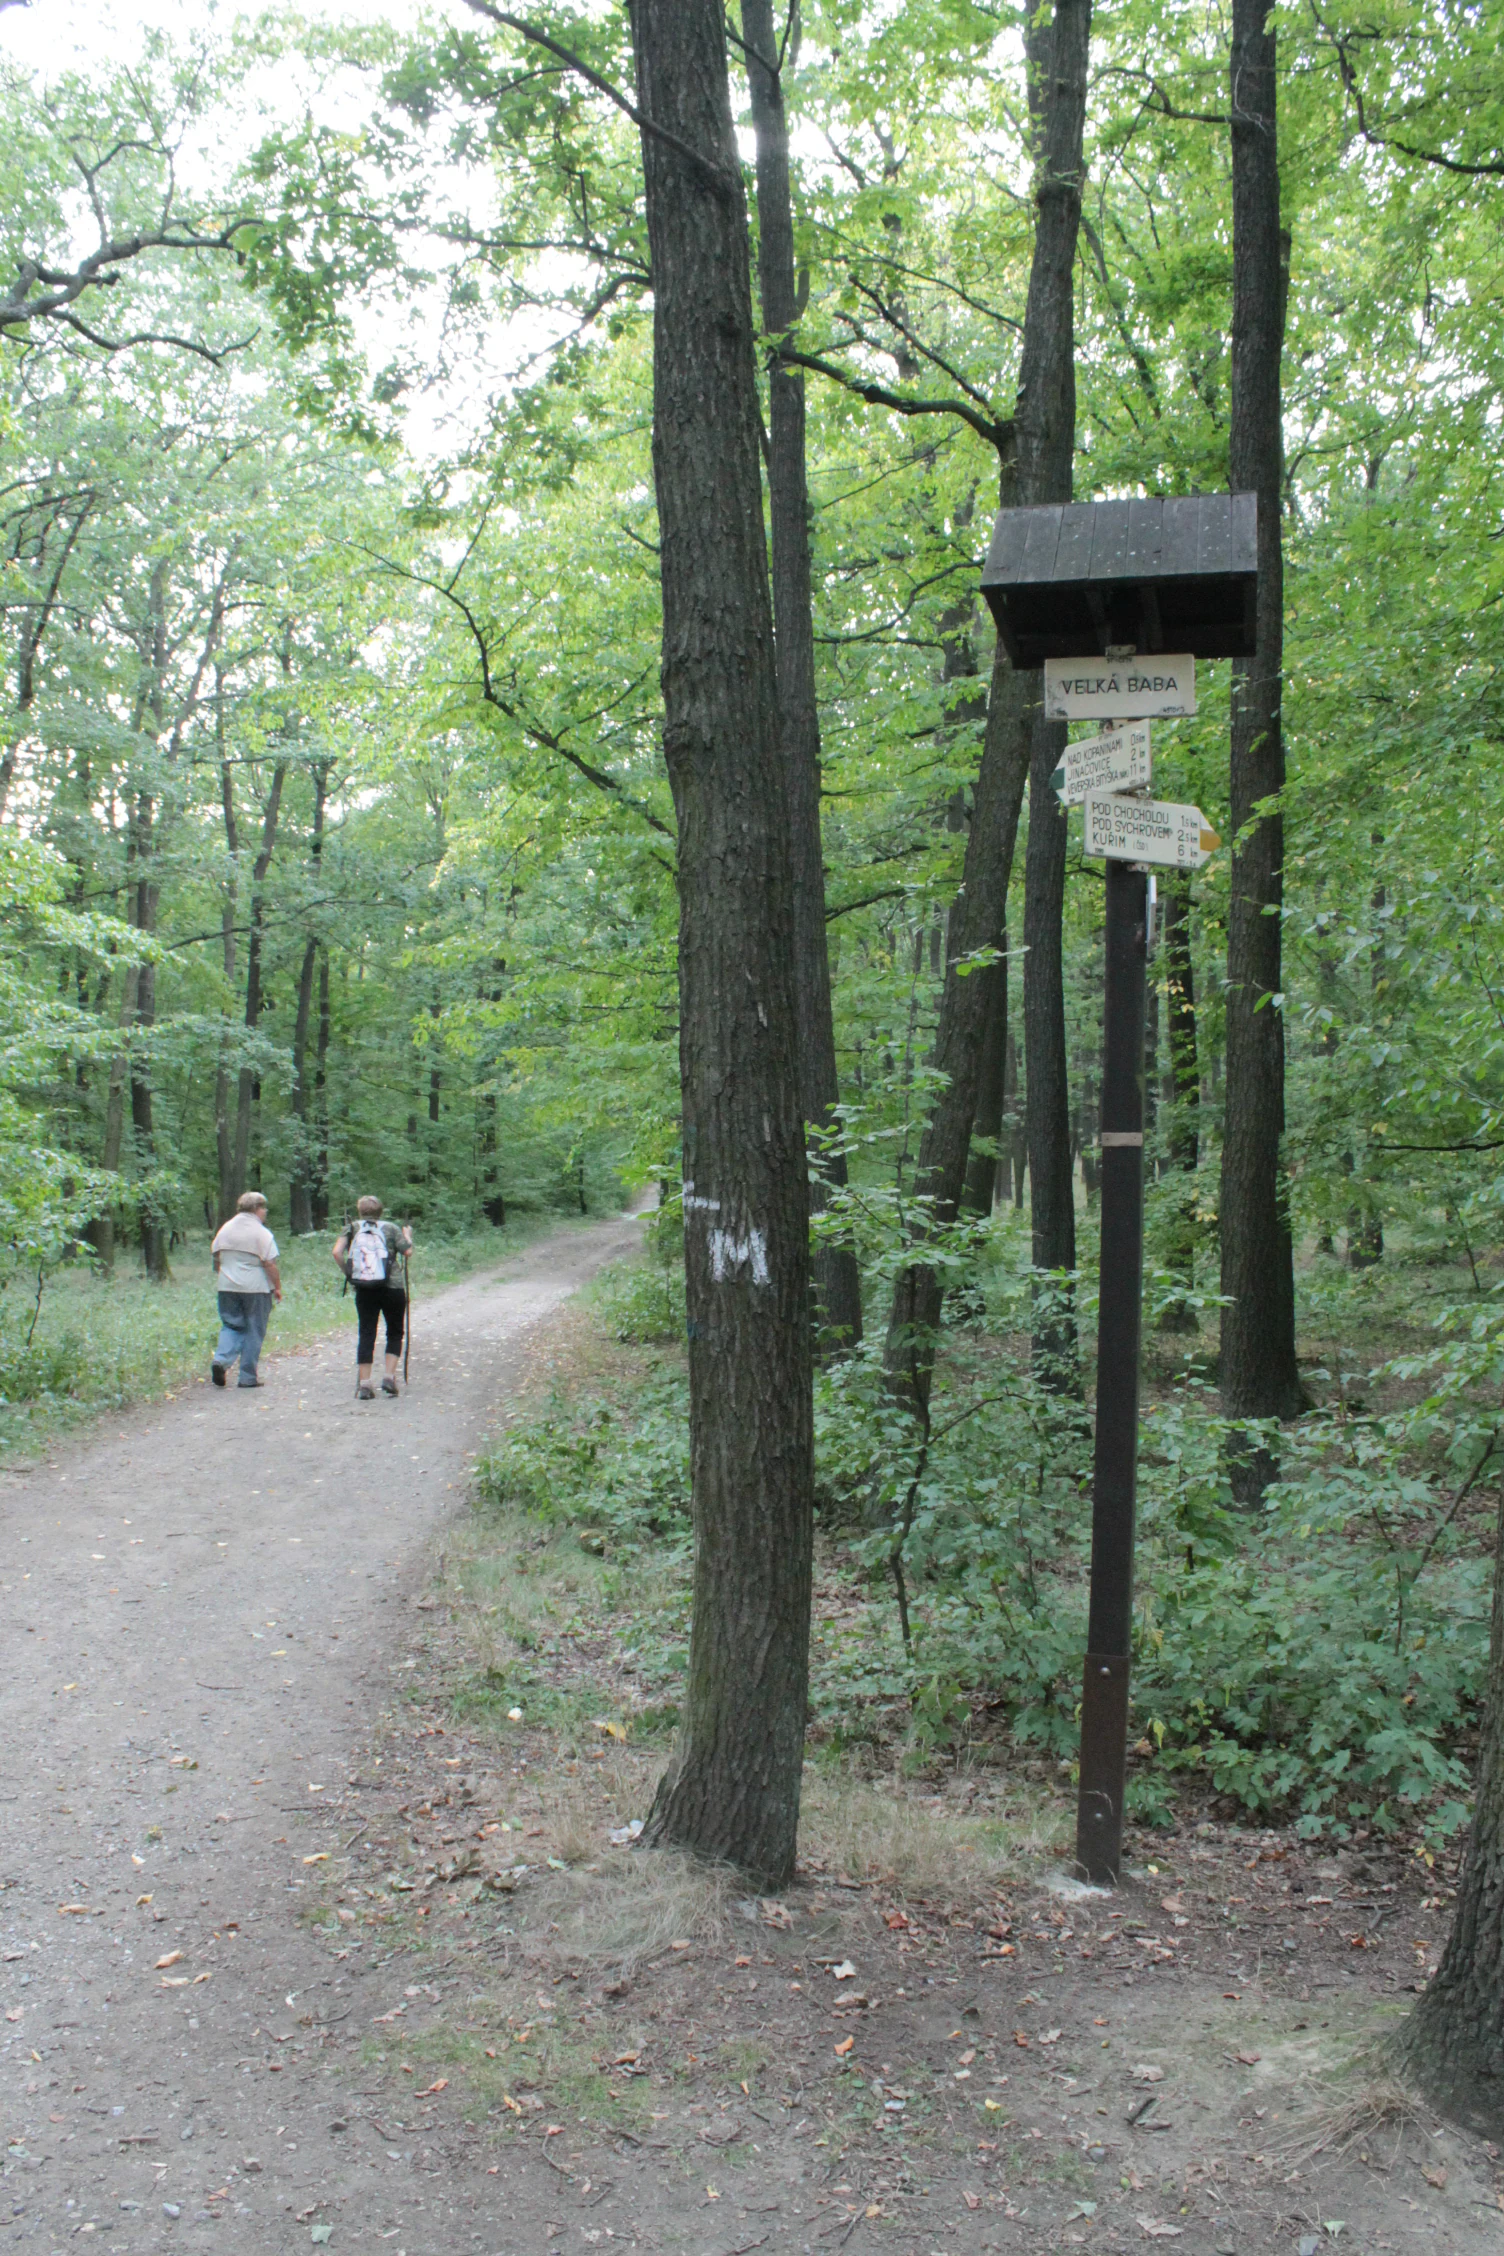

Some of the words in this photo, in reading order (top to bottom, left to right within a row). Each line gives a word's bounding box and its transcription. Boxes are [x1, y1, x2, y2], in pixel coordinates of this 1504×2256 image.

[1061, 673, 1120, 695] VELKÁ
[1127, 677, 1178, 692] BABA
[1067, 752, 1082, 766] NAD
[1083, 738, 1123, 761] KOPANINAMI
[1130, 748, 1137, 761] 2
[1129, 763, 1137, 777] 11
[1092, 802, 1111, 816] POD
[1113, 805, 1169, 825] CHOCHOLOU
[1190, 816, 1198, 828] km
[1092, 816, 1112, 831] POD
[1114, 820, 1170, 839] SYCHROVEM
[1190, 831, 1198, 843] km
[1092, 831, 1126, 848] KUŘIM
[1177, 844, 1185, 857] 6
[1190, 846, 1198, 858] km
